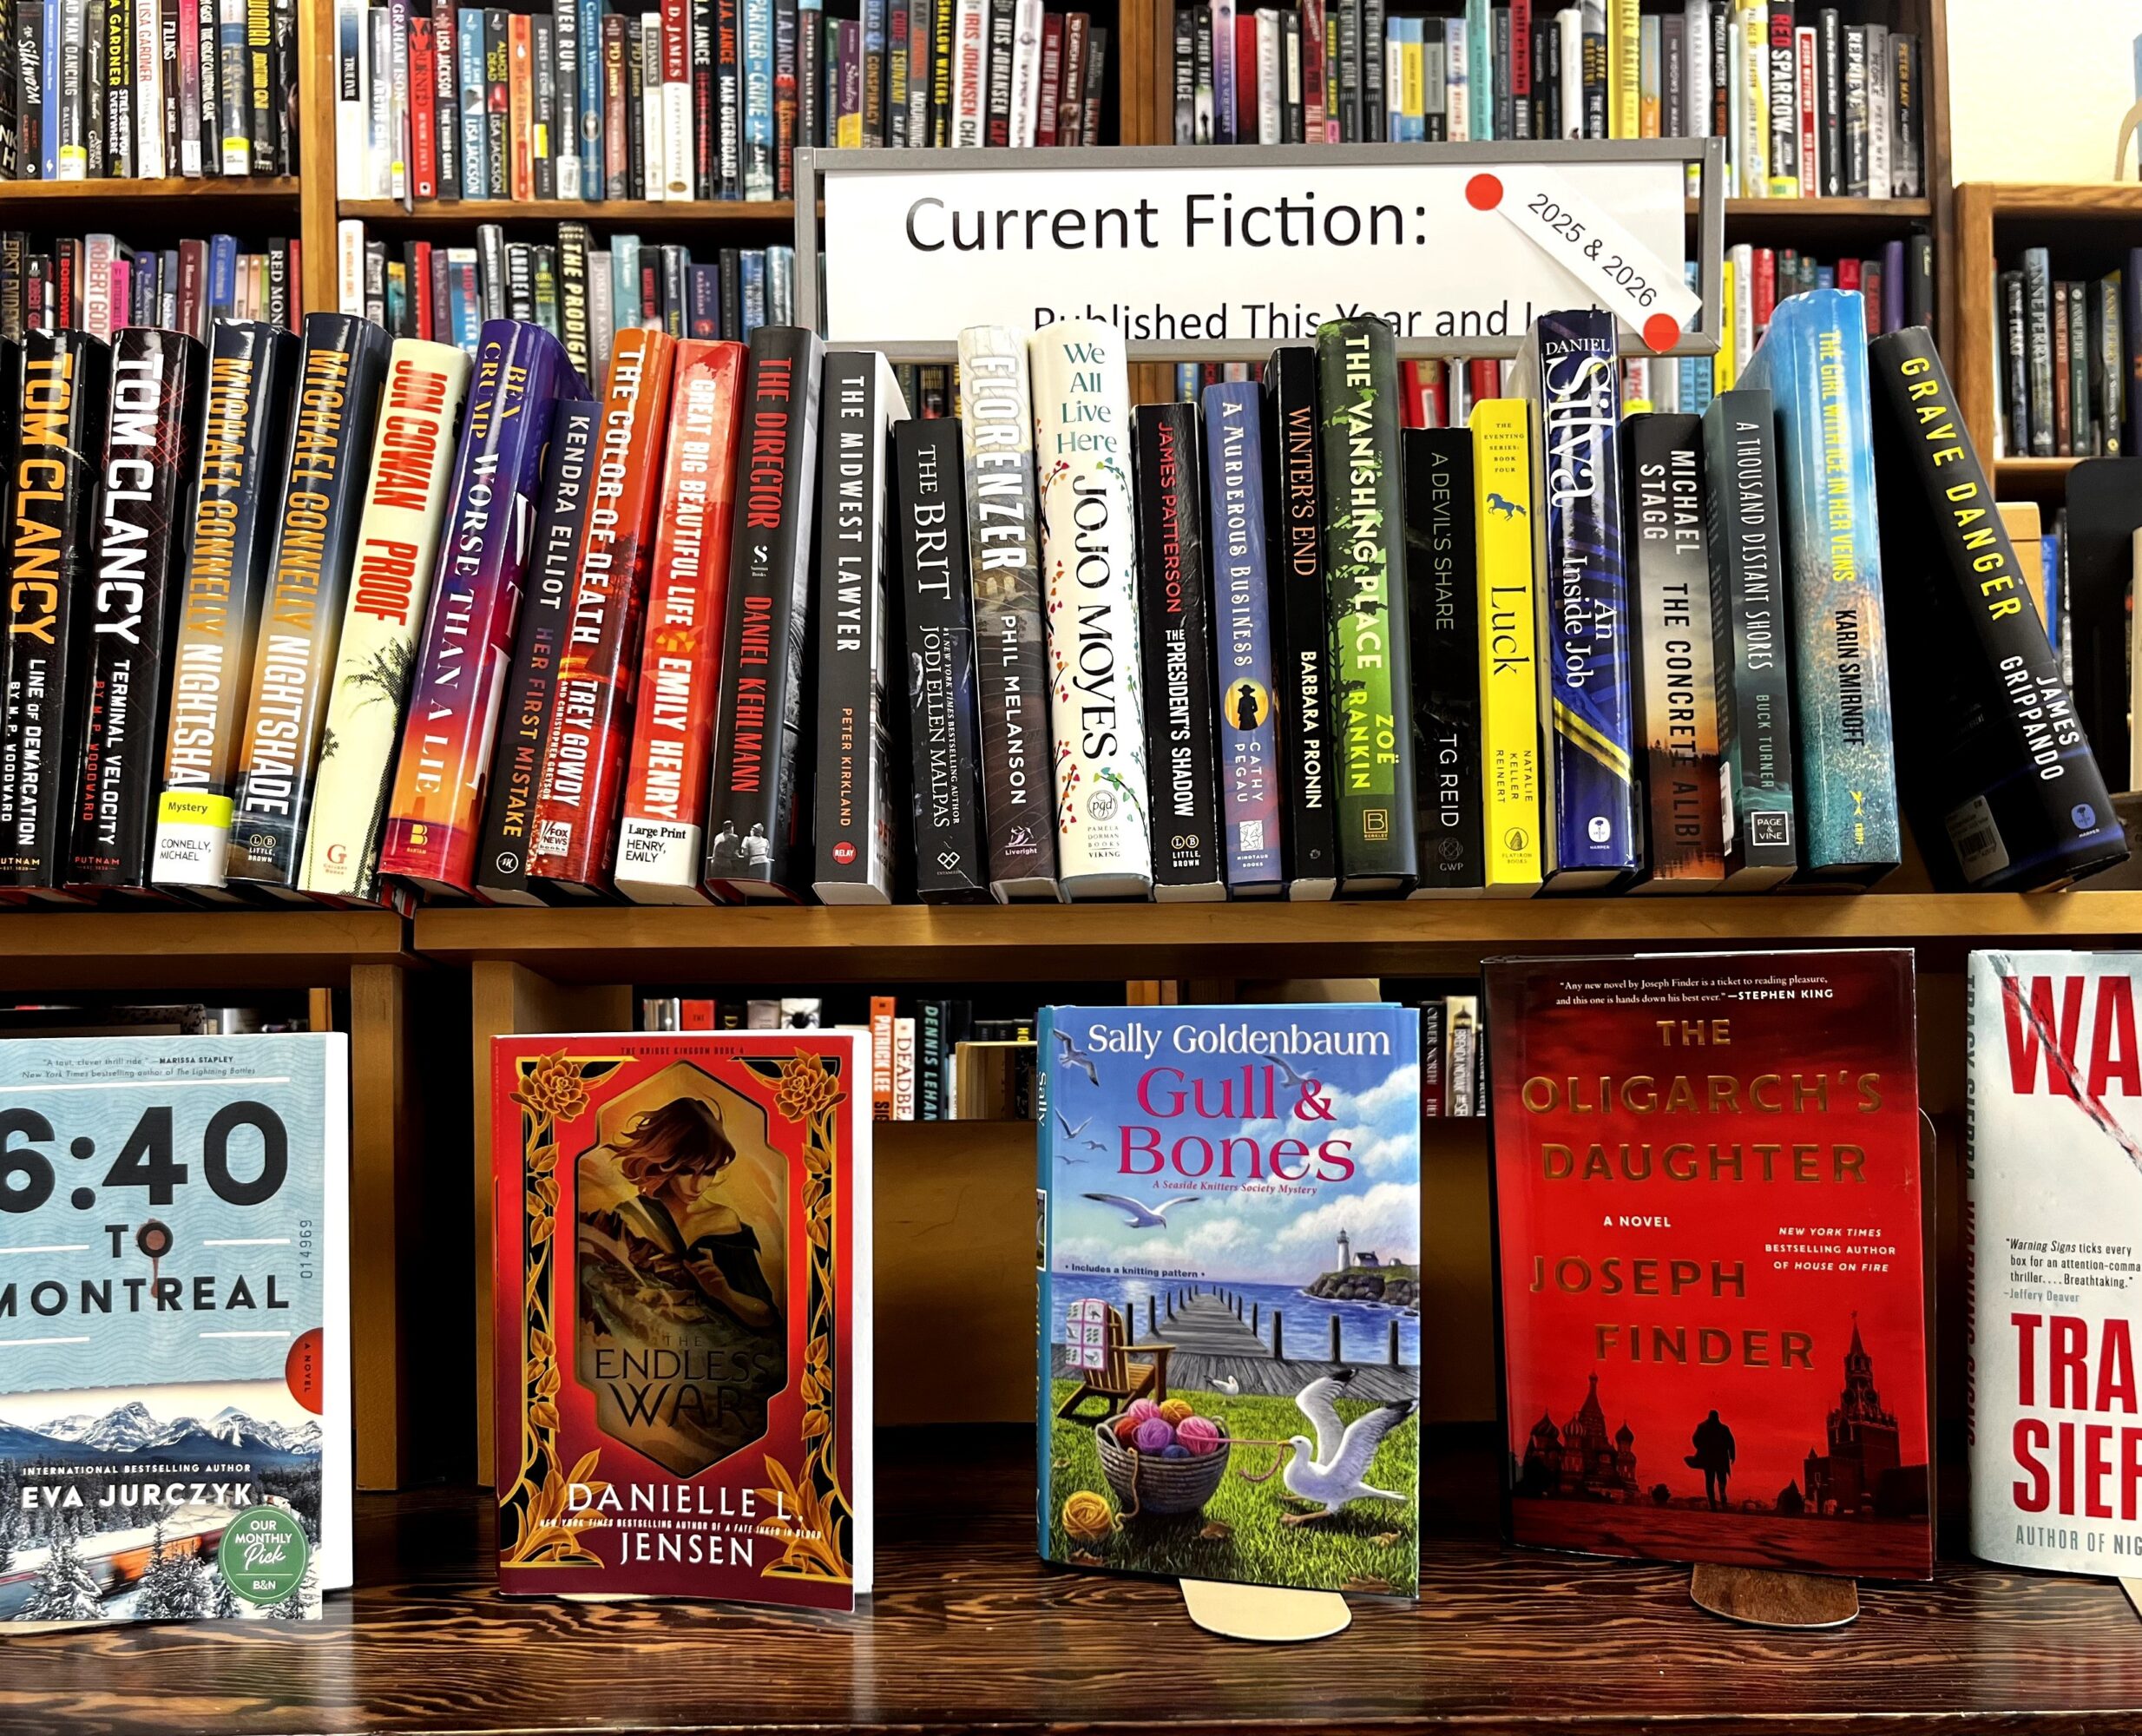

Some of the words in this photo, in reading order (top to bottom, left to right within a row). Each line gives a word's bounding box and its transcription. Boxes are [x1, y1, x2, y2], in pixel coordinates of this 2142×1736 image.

[65, 17, 78, 42] MAN
[109, 13, 122, 86] GARDNER
[391, 3, 405, 63] GRAHAM
[963, 13, 980, 40] IRIS
[993, 18, 1011, 49] IRIS
[1176, 36, 1193, 54] NO
[1771, 14, 1792, 47] RED
[64, 46, 78, 96] DANCING
[559, 39, 576, 71] RUN
[891, 50, 907, 104] TSUNAMI
[961, 43, 979, 116] JOHANSEN
[1176, 59, 1193, 102] TRACE
[991, 52, 1011, 114] JOHANSEN
[1771, 49, 1793, 135] SPARROW
[490, 114, 501, 135] LISA
[490, 136, 502, 194] JACKSON
[905, 197, 1160, 252] Current
[1186, 192, 1426, 247] Fiction:
[270, 250, 283, 280] RED
[562, 245, 585, 281] THE
[1528, 193, 1587, 243] 2025
[1584, 239, 1603, 261] &
[1601, 255, 1658, 307] 2026
[1435, 299, 1508, 337] and
[1063, 342, 1106, 365] We
[1545, 338, 1611, 356] DANIEL
[22, 352, 74, 445] TOM
[389, 359, 449, 415] JON
[841, 375, 864, 419] THE
[1069, 371, 1102, 393] All
[292, 349, 350, 484] MICHAEL
[1061, 400, 1112, 424] Live
[1545, 355, 1616, 509] Silva
[372, 416, 440, 513] COWAN
[555, 415, 590, 514] KENDRA
[970, 354, 1028, 572] FLORENZER
[1056, 431, 1118, 455] Here
[1159, 421, 1176, 490] JAMES
[1288, 404, 1315, 519] WINTER'S
[838, 431, 864, 543] MIDWEST
[1639, 464, 1670, 540] STAGG
[1671, 450, 1700, 556] MICHAEL
[1900, 357, 1965, 467] GRAVE
[1945, 482, 2022, 621] DANGER
[9, 459, 66, 644] CLANCY
[272, 491, 332, 632] CONNELLY
[539, 525, 573, 611] ELLIOT
[1161, 494, 1183, 614] PATTERSON
[1291, 525, 1317, 576] END
[353, 538, 419, 627] PROOF
[838, 556, 863, 652] LAWYER
[529, 626, 555, 671] HER
[740, 595, 772, 669] DANIEL
[920, 624, 942, 676] JODI
[1001, 615, 1021, 668] PHIL
[1490, 585, 1531, 677] Luck
[1835, 609, 1859, 660] KARIN
[27, 659, 47, 700] LINE
[653, 656, 693, 732] EMILY
[1300, 651, 1319, 733] BARBARA
[1837, 662, 1865, 747] SMIRNOFF
[26, 703, 41, 721] OF
[245, 635, 312, 816] NIGHTSHADE
[519, 677, 547, 741] FIRST
[926, 678, 946, 745] ELLEN
[1756, 694, 1771, 729] BUCK
[1999, 654, 2065, 781] GRIPPANDO
[2035, 675, 2080, 746] JAMES
[731, 677, 767, 793] KEHLMANN
[1004, 675, 1028, 806] MELANSON
[17, 726, 43, 846] DEMARCATION
[643, 739, 685, 820] HENRY
[930, 747, 950, 828] MALPAS
[1304, 739, 1323, 809] PRONIN
[1758, 736, 1775, 789] TURNER
[168, 800, 208, 815] Mystery
[502, 746, 536, 838] MISTAKE
[159, 851, 200, 862] MICHAEL
[161, 838, 211, 853] CONNELLY,
[627, 824, 659, 839] Large
[660, 825, 687, 840] Print
[834, 848, 855, 858] RELAY
[1005, 847, 1038, 857] Liveright
[1801, 988, 1835, 1000] KING
[923, 1005, 939, 1066] DENNIS
[1087, 1023, 1162, 1061] Sally
[1173, 1023, 1391, 1057] Goldenbaum
[1656, 1018, 1732, 1047] THE
[198, 1055, 234, 1064] STAPLEY
[874, 1071, 891, 1093] LEE
[1135, 1063, 1278, 1121] Gull
[1293, 1078, 1337, 1121] &
[1521, 1069, 1883, 1115] OLIGARCH'S
[0, 1100, 288, 1214] 6:40
[1117, 1125, 1355, 1182] Bones
[1541, 1142, 1868, 1183] DAUGHTER
[1152, 1180, 1161, 1190] A
[1162, 1180, 1199, 1193] Seaside
[1199, 1181, 1239, 1194] Knitters
[1239, 1182, 1276, 1195] Society
[1278, 1184, 1318, 1196] Mystery
[105, 1220, 174, 1259] TO
[299, 1220, 313, 1279] 014969
[1764, 1242, 1842, 1255] BESTSELLING
[1845, 1244, 1897, 1257] AUTHOR
[1777, 1226, 1806, 1238] NEW
[1809, 1226, 1843, 1238] YORK
[1845, 1227, 1883, 1239] TIMES
[2050, 1239, 2077, 1256] Signs
[2079, 1241, 2103, 1255] ticks
[2105, 1244, 2132, 1258] every
[1070, 1263, 1111, 1275] Includes
[1114, 1267, 1120, 1276] a
[1121, 1266, 1160, 1279] knitting
[1161, 1268, 1199, 1279] pattern
[1528, 1255, 1748, 1300] JOSEPH
[2047, 1290, 2081, 1303] Deaver
[1594, 1323, 1816, 1371] FINDER
[23, 1463, 119, 1476] INTERNATIONAL
[124, 1463, 200, 1475] BESTSELLING
[206, 1463, 252, 1473] AUTHOR
[22, 1483, 85, 1509] EVA
[99, 1482, 253, 1508] JURCZYK
[568, 1483, 758, 1519] DANIELLE
[777, 1489, 804, 1522] L.
[234, 1531, 293, 1544] MONTHLY
[250, 1520, 277, 1531] OUR
[620, 1531, 754, 1568] JENSEN
[244, 1542, 286, 1571] Pick
[253, 1580, 277, 1590] B&N
